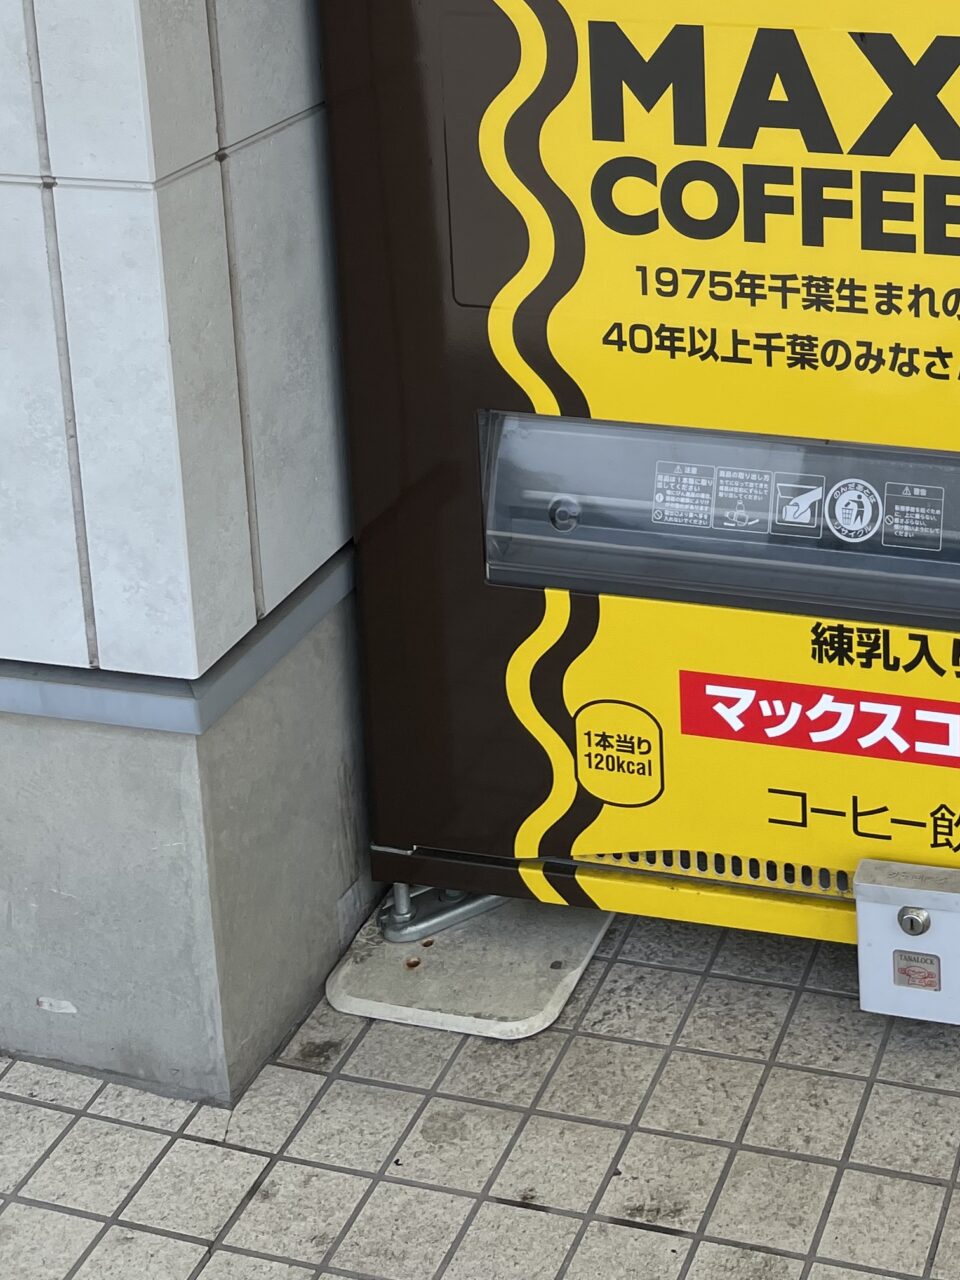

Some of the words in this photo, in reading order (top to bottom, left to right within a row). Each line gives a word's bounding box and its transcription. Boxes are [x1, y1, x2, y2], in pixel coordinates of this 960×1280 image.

[583, 729, 653, 757] 1本当り
[583, 752, 653, 778] 120kcal
